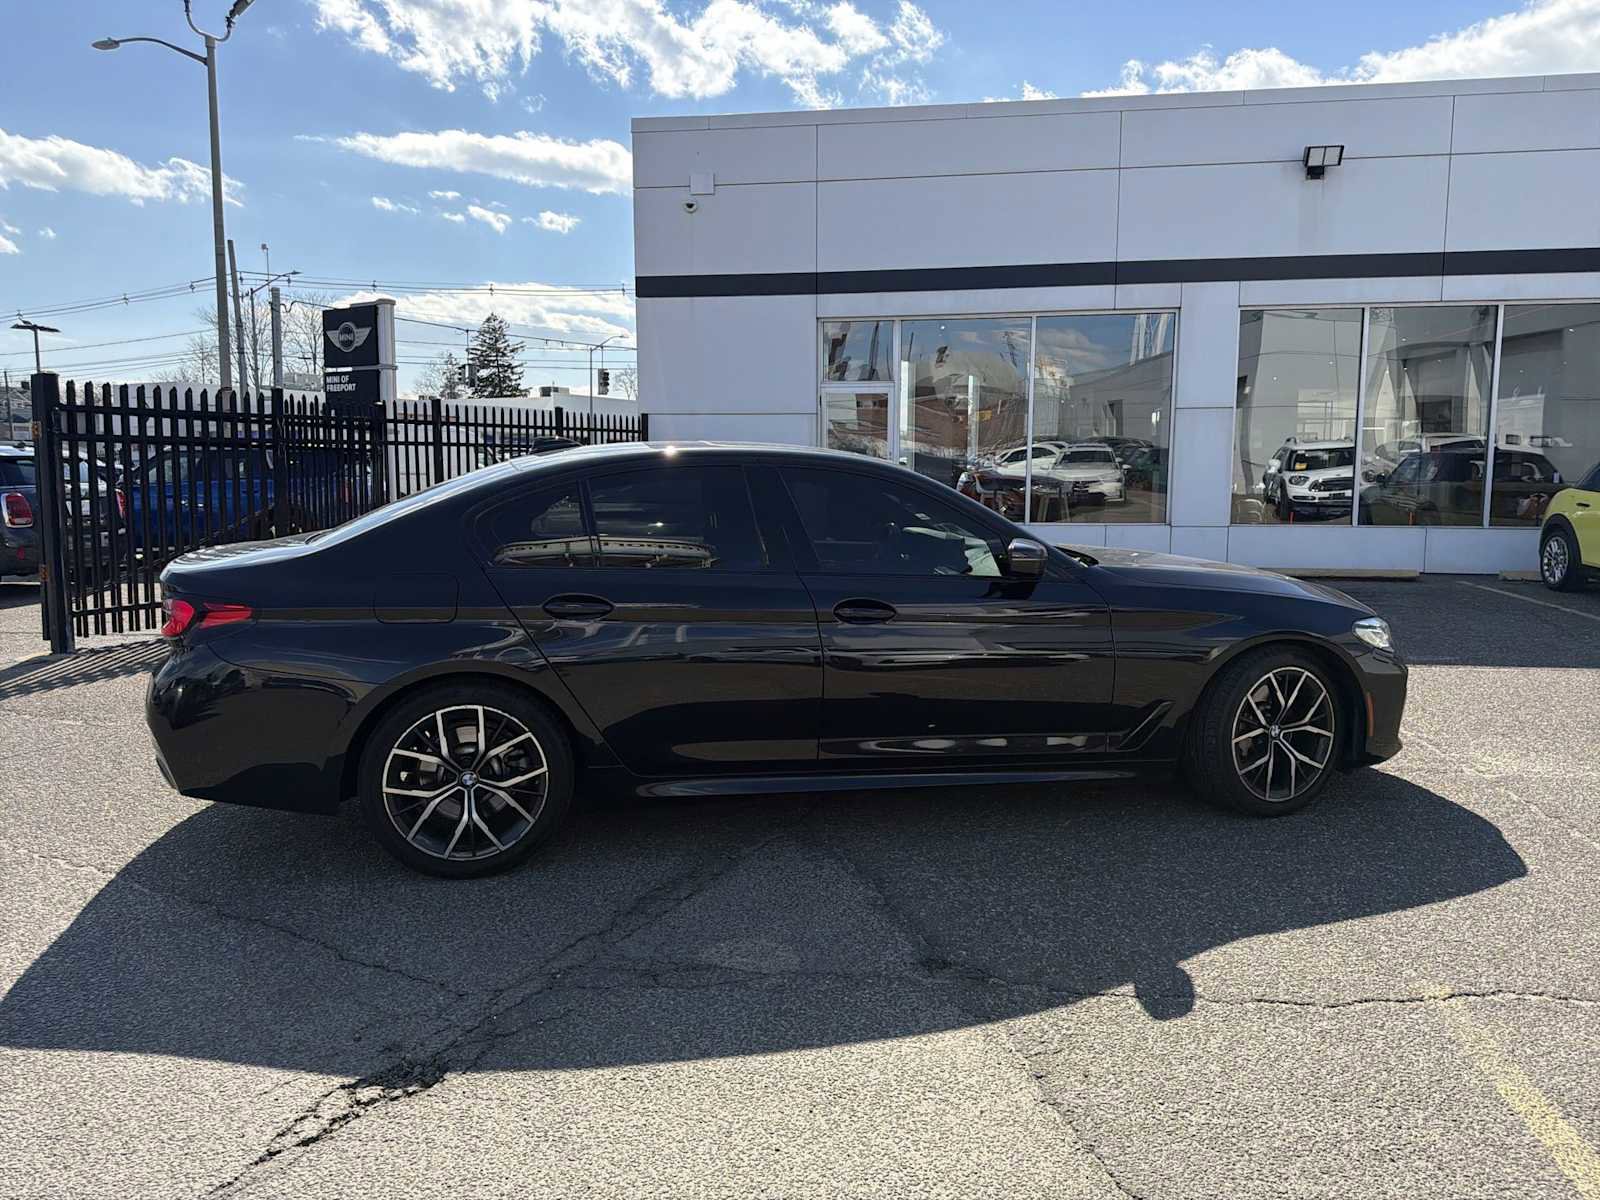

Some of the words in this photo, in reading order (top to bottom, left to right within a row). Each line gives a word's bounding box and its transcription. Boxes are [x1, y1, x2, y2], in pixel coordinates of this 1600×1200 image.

[339, 333, 354, 341] MINI
[326, 375, 340, 383] MINI
[341, 375, 350, 383] OF
[326, 383, 356, 392] FREEPORT
